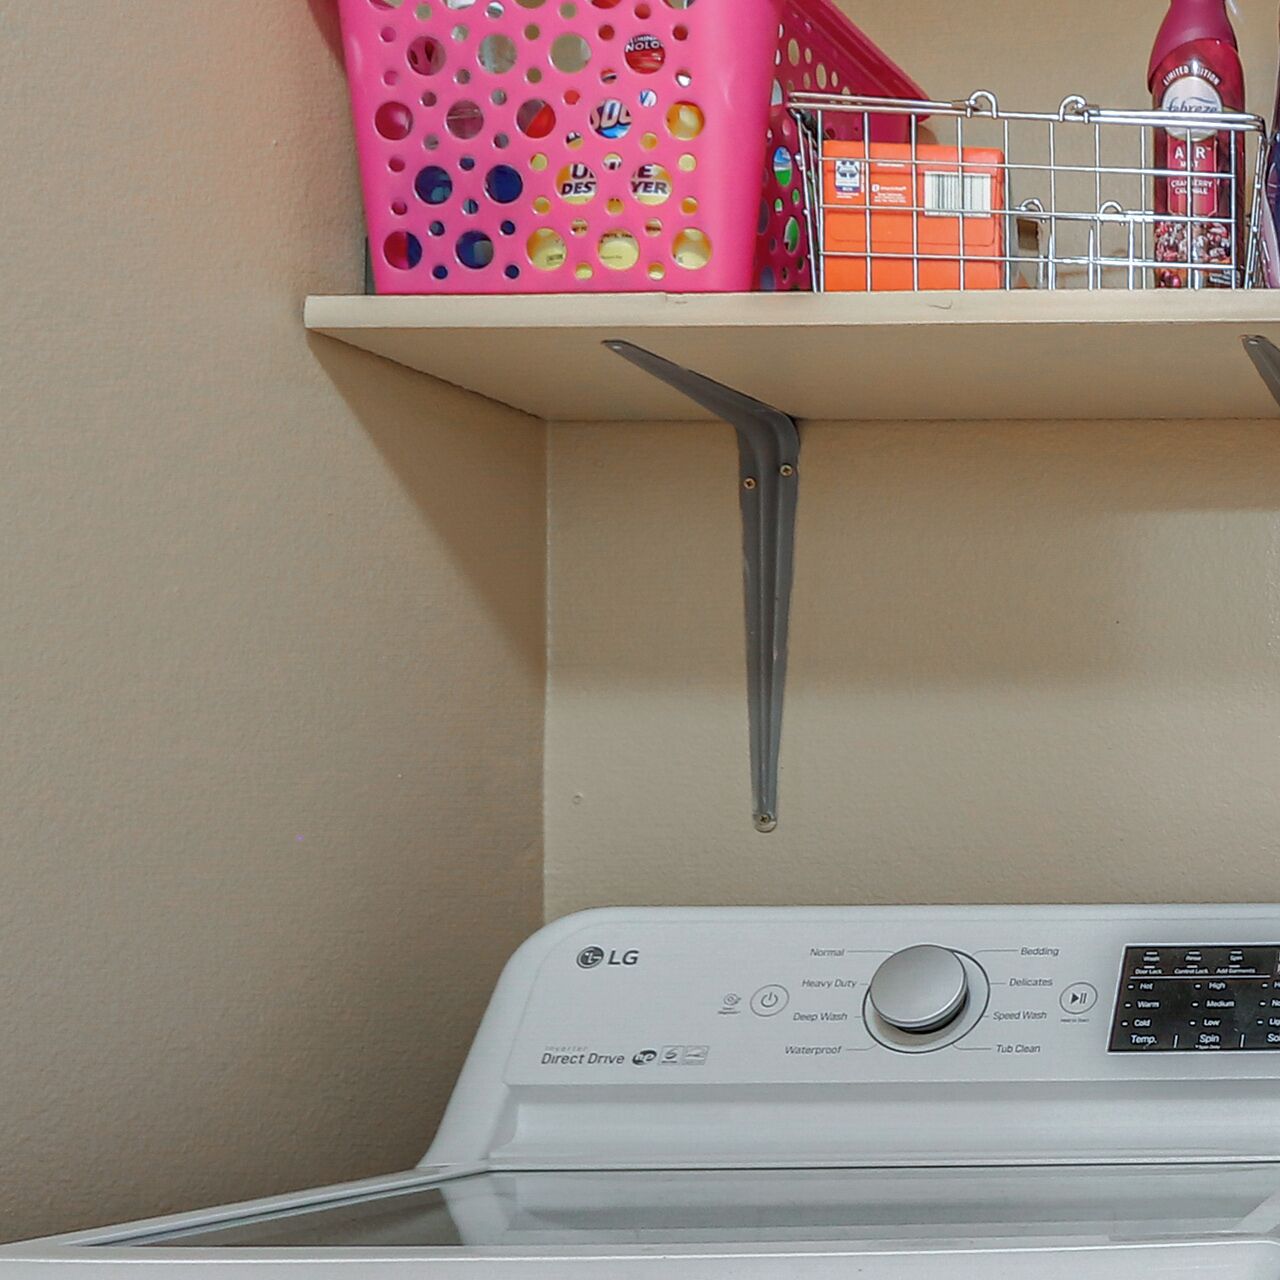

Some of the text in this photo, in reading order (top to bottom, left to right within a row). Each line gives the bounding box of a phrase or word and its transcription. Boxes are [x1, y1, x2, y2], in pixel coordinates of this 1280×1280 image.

[1162, 65, 1189, 85] LIMITED
[1175, 146, 1206, 160] AR
[809, 948, 845, 957] Normal
[1020, 947, 1060, 957] Bedding
[607, 949, 640, 966] LG
[801, 978, 857, 988] Heavy Duty
[1008, 977, 1054, 987] Delicates
[1208, 982, 1226, 990] High
[1137, 1000, 1160, 1008] Warm
[792, 1012, 848, 1022] Deep Wash
[992, 1011, 1048, 1020] Speed Wash
[1133, 1019, 1151, 1027] Cold
[1203, 1019, 1221, 1027] Low
[1131, 1034, 1157, 1044] Temp.
[1199, 1034, 1220, 1044] Spin
[784, 1045, 842, 1056] Waterproof
[996, 1044, 1041, 1053] Tub Clean
[540, 1052, 584, 1065] Direct
[587, 1052, 626, 1065] Drive
